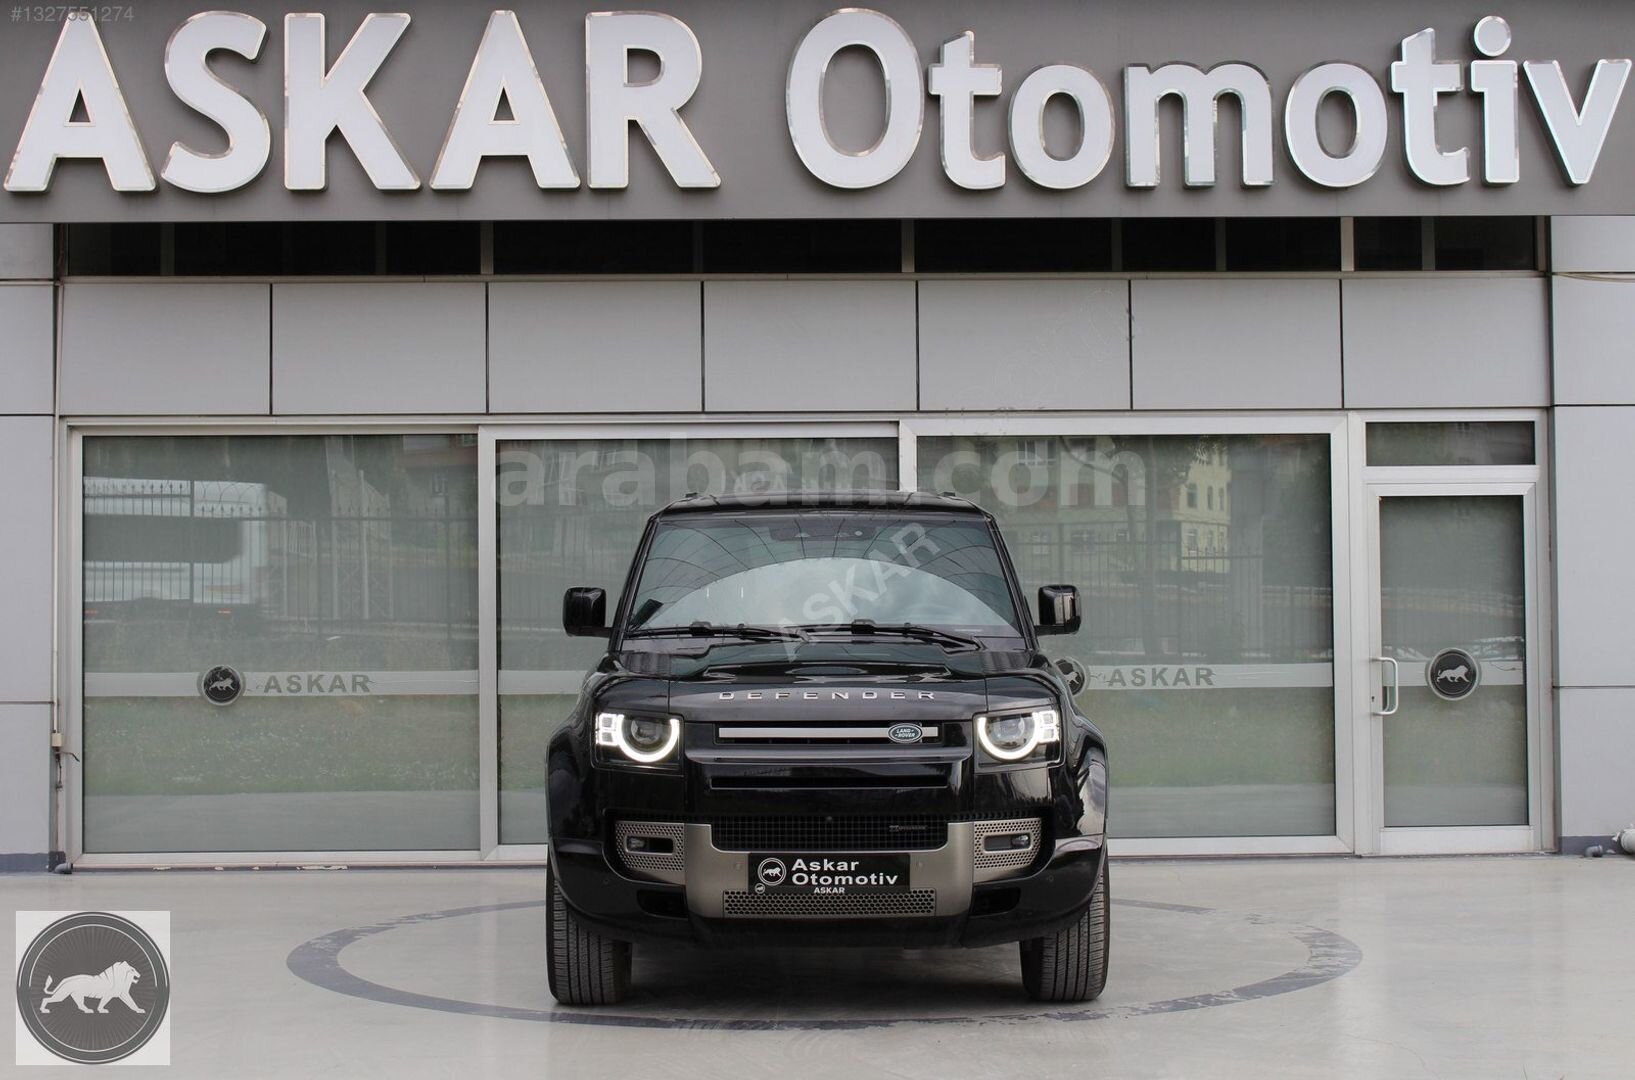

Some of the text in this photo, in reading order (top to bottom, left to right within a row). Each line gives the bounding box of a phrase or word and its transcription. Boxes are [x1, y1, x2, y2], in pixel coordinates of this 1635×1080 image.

[4, 7, 1634, 194] ASKAR Otomotiv
[263, 674, 371, 693] ASKAR
[1108, 667, 1214, 687] ASKAR
[791, 859, 859, 871] Askar
[791, 873, 898, 885] Otomotiv
